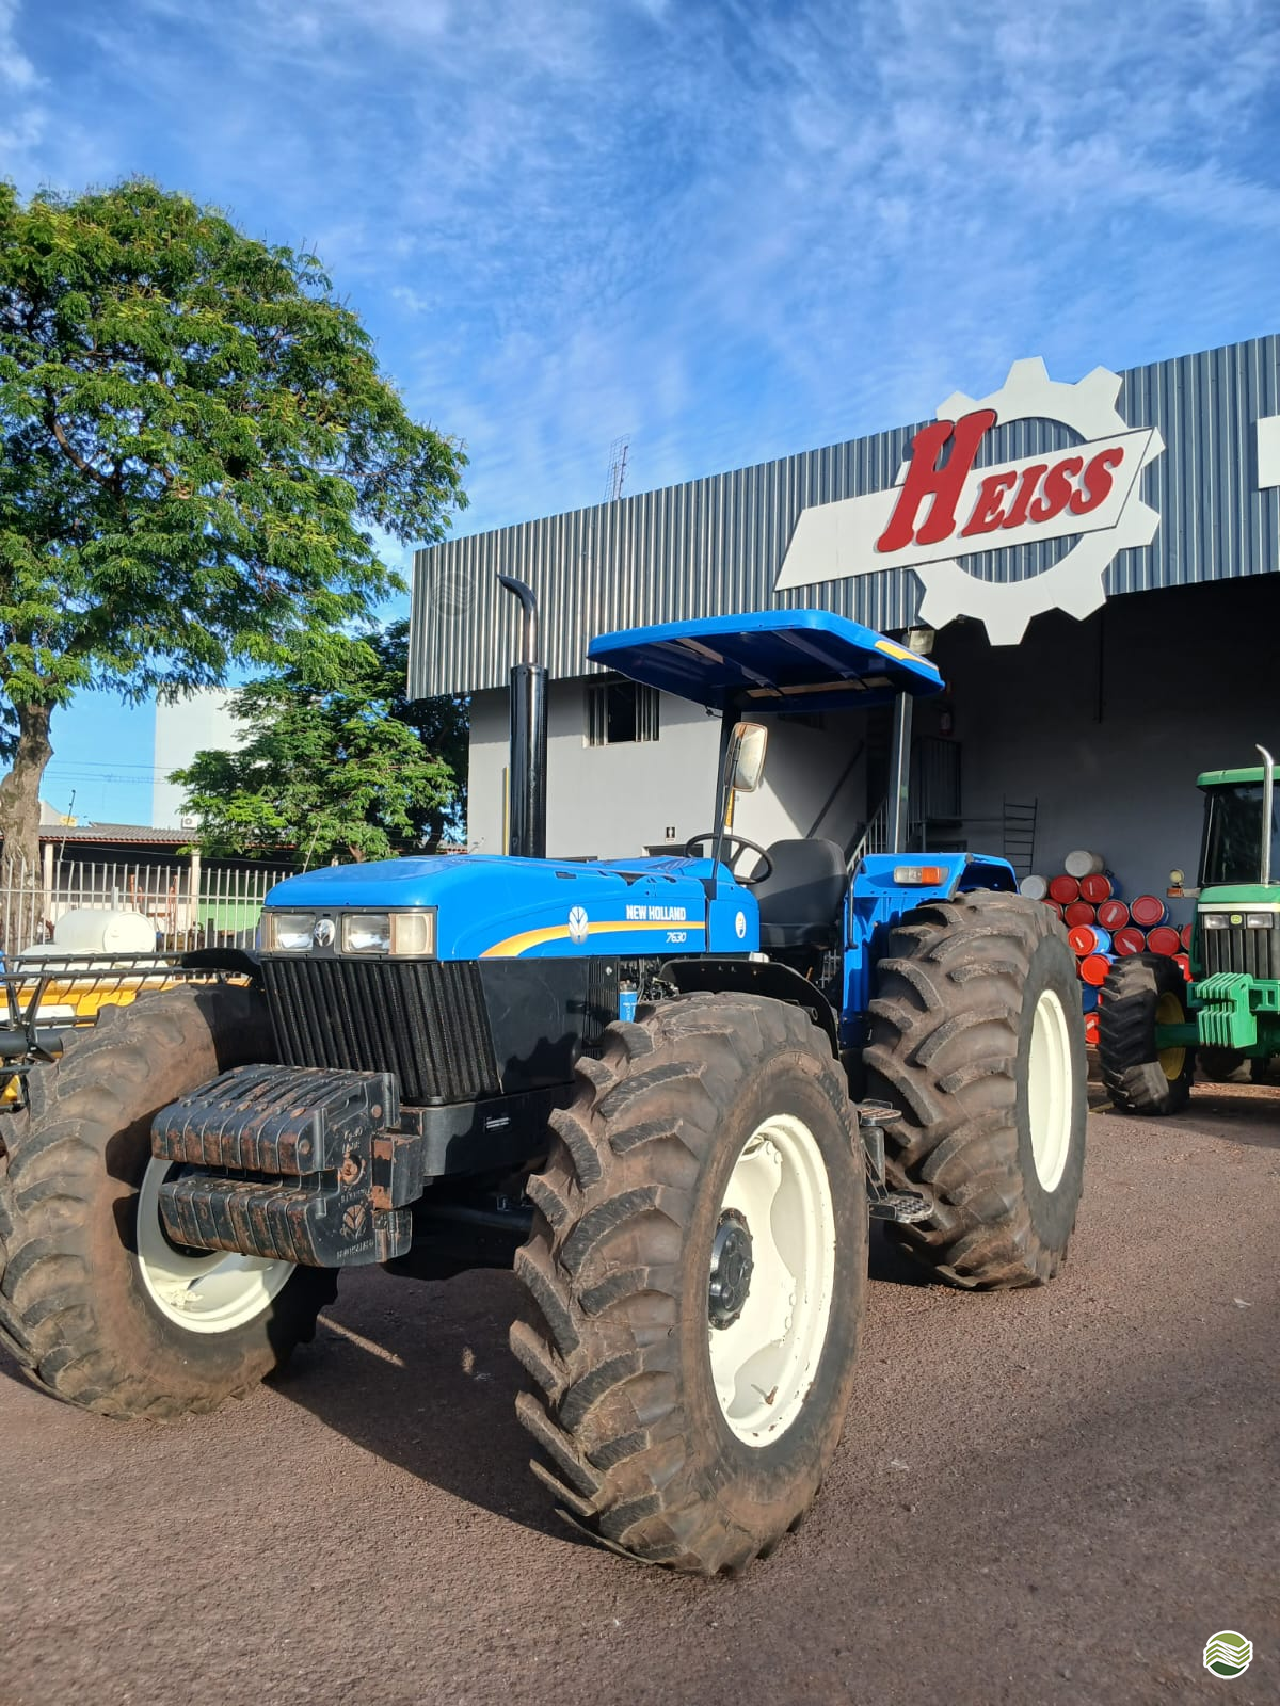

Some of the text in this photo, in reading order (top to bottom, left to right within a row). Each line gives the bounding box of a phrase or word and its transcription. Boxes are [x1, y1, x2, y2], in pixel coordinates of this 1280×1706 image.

[877, 409, 1124, 553] HEISS
[626, 904, 687, 920] NEW HOLLAND
[666, 932, 687, 944] 7630
